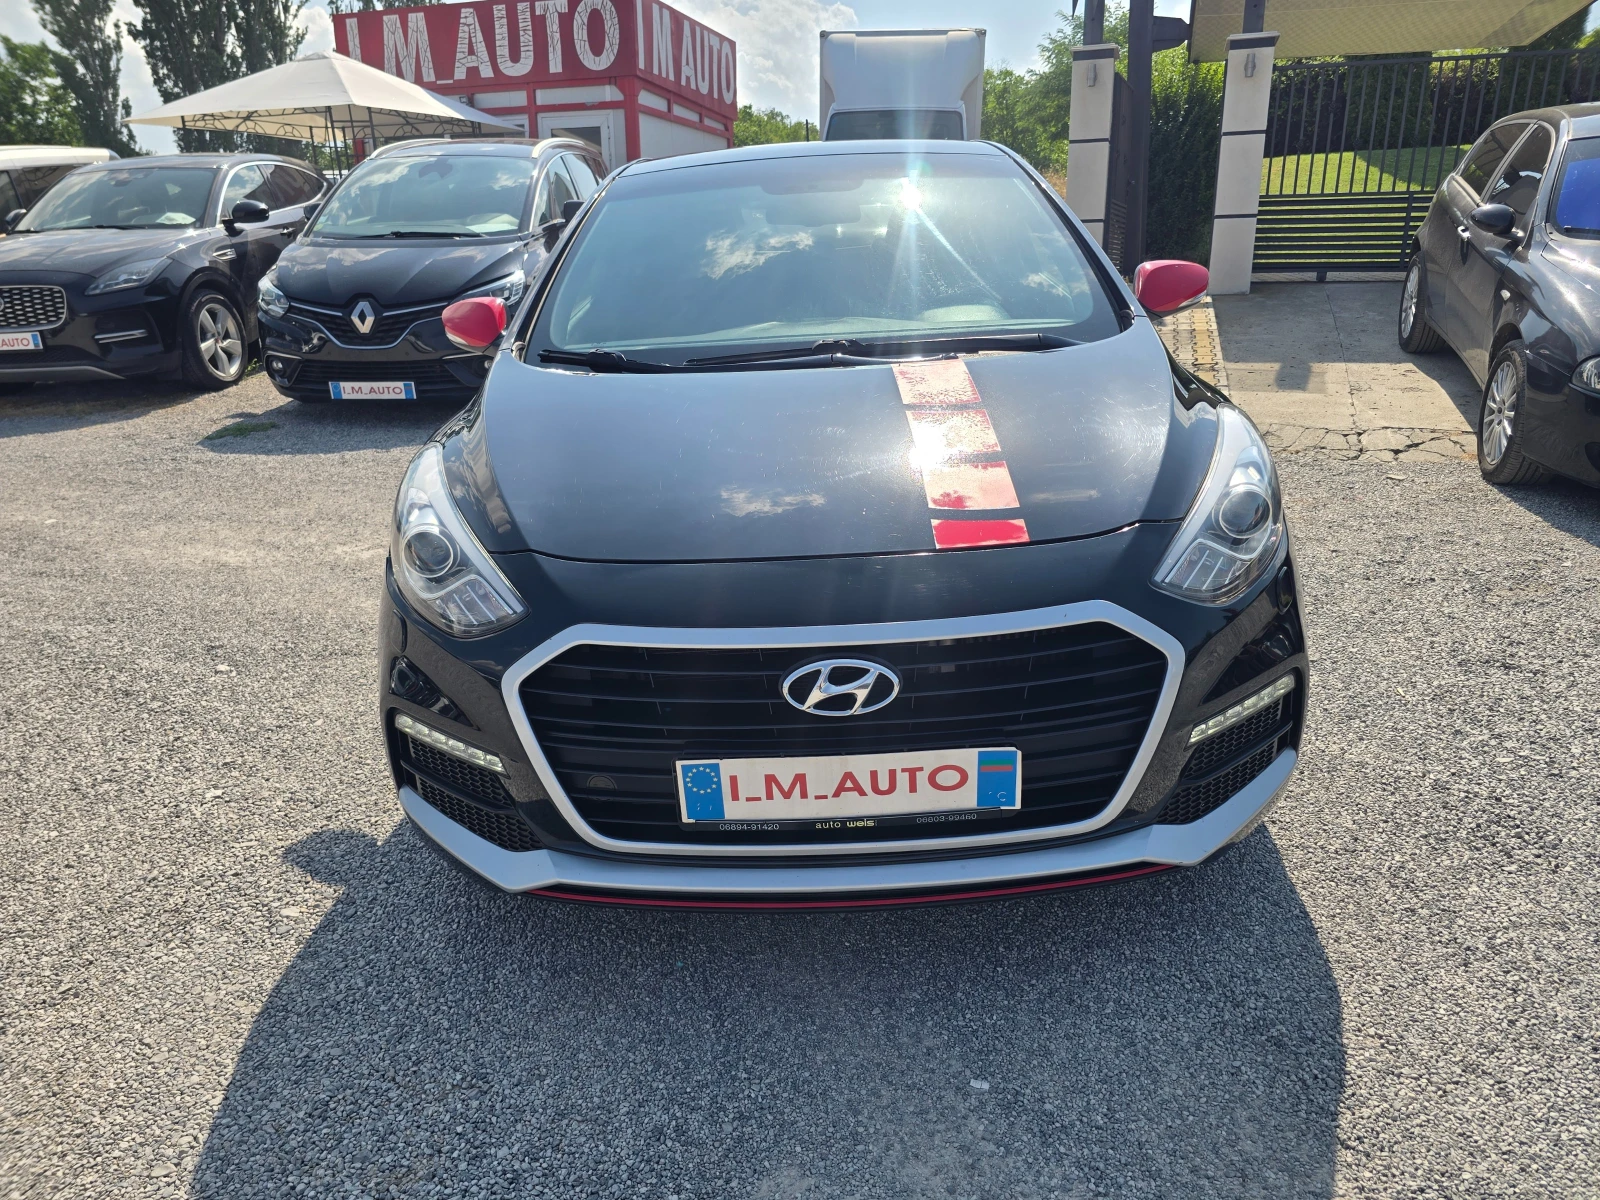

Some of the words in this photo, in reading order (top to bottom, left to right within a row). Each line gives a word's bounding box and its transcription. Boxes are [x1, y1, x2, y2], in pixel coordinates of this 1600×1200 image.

[636, 0, 645, 70] I
[652, 2, 675, 82] M
[681, 19, 735, 105] AUTO
[0, 337, 30, 348] AUTO
[729, 764, 969, 803] I_M_AUTO
[719, 823, 780, 831] 06894-91420
[815, 820, 841, 829] auto
